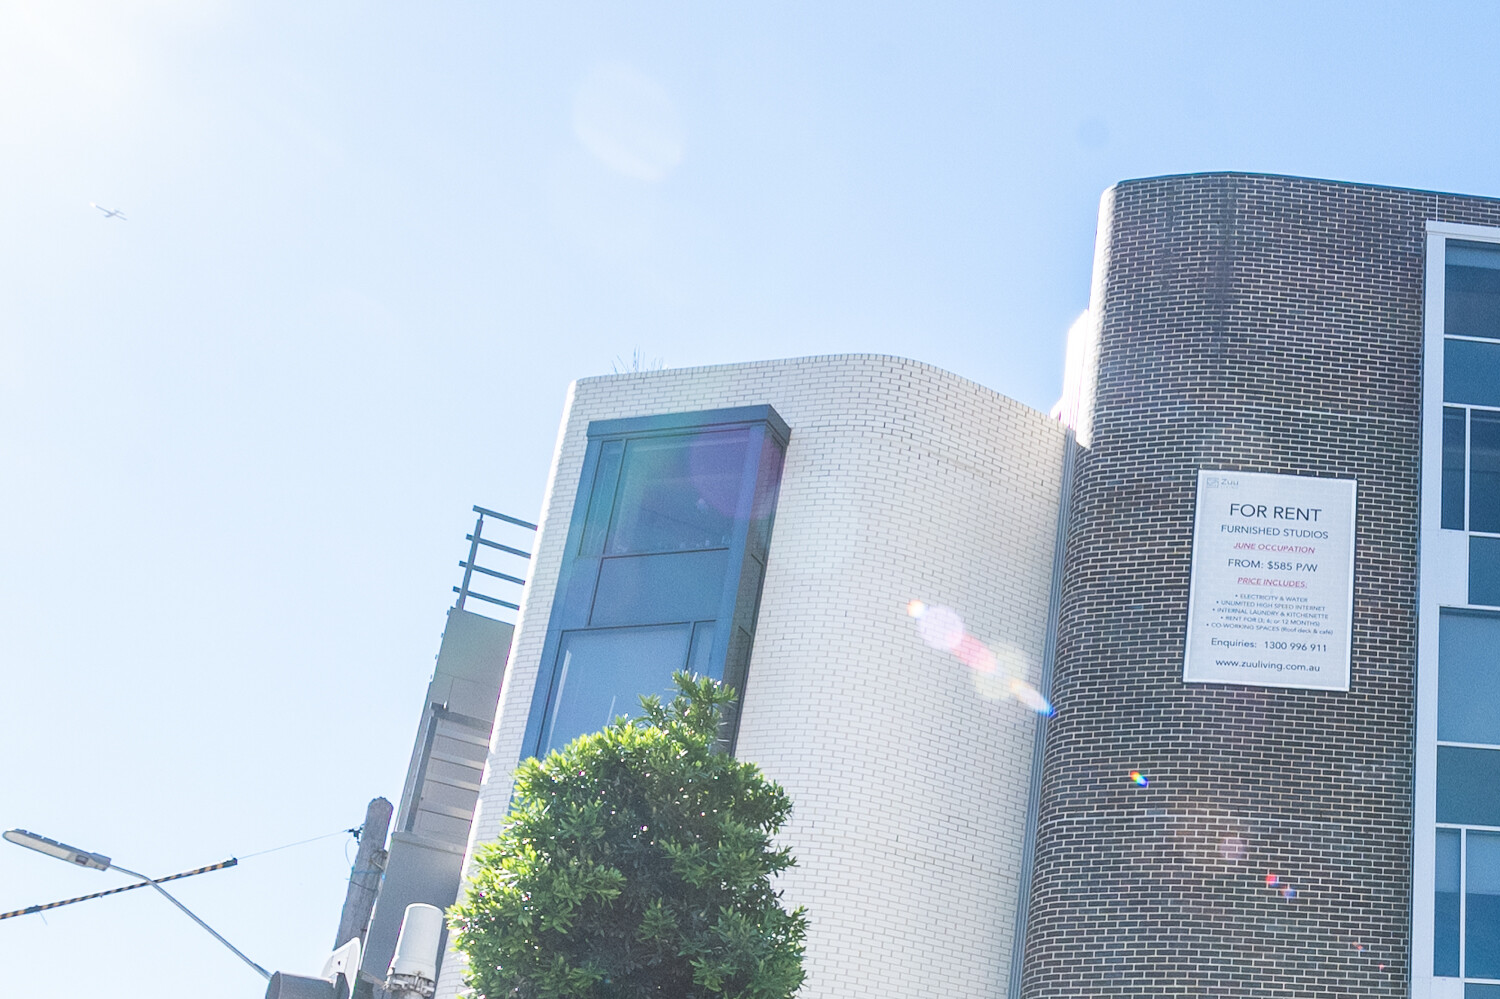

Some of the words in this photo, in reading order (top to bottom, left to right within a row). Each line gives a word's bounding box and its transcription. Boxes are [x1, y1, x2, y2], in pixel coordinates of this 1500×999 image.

[1229, 503, 1267, 519] FOR
[1273, 506, 1322, 522] RENT
[1221, 524, 1280, 537] FURNISHED
[1283, 528, 1329, 539] STUDIOS
[1233, 542, 1256, 551] JUNE
[1257, 543, 1316, 554] OCCUPATION
[1227, 558, 1264, 569] FROM:
[1266, 560, 1293, 571] $585
[1296, 563, 1318, 573] P/W
[1237, 577, 1262, 586] PRICE
[1286, 611, 1329, 619] KITCHENETTE
[1211, 637, 1257, 649] Enquiries:
[1264, 640, 1287, 650] 1300
[1290, 642, 1308, 651] 996
[1310, 643, 1327, 652] 911
[1215, 658, 1321, 673] www.zuuliving.com.au
